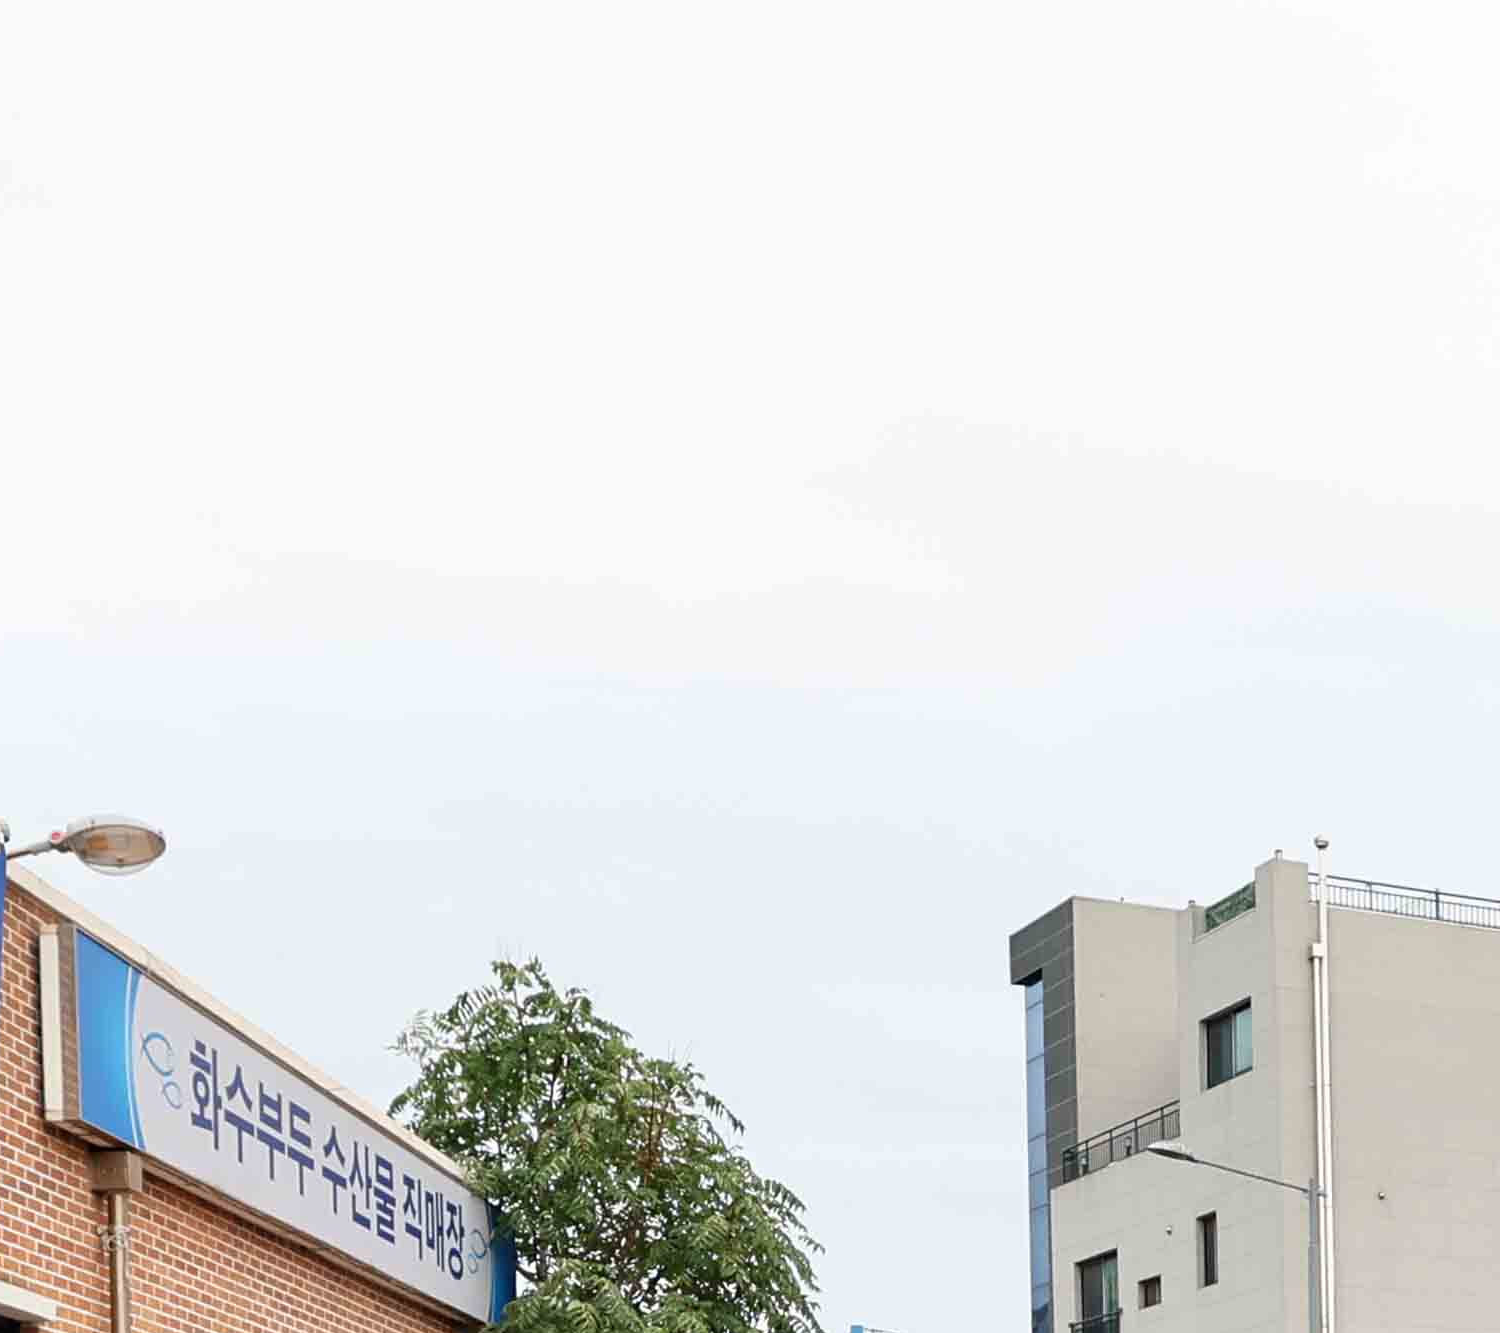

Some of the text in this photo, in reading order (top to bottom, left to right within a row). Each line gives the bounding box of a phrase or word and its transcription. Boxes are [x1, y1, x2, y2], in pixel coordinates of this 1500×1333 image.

[189, 1039, 465, 1281] 화수부두 수산물 직매장
